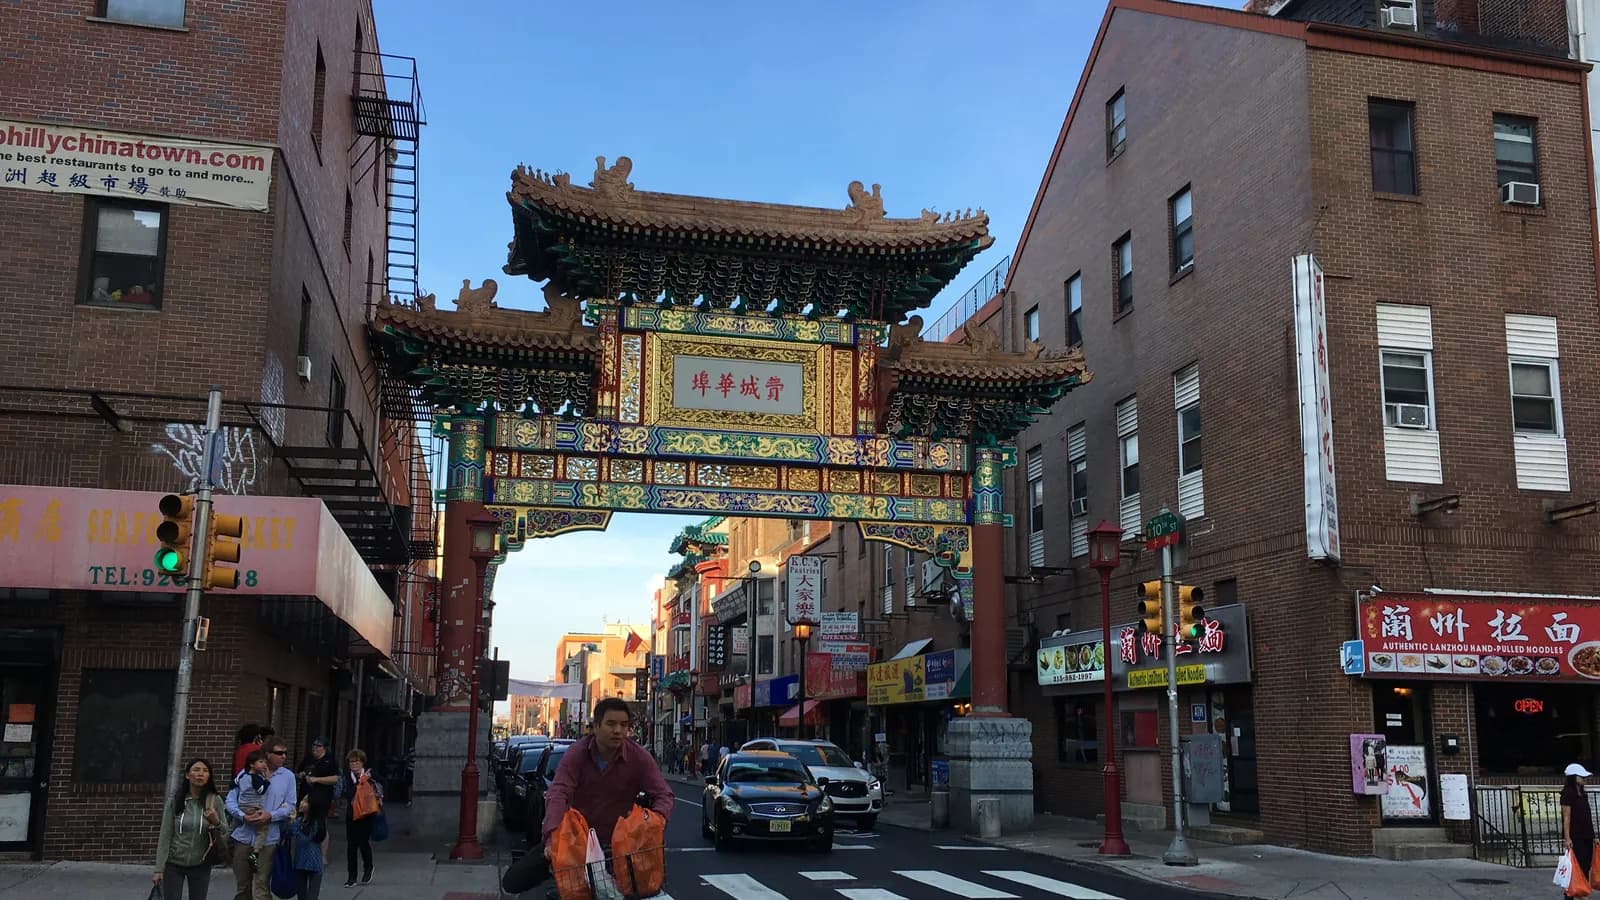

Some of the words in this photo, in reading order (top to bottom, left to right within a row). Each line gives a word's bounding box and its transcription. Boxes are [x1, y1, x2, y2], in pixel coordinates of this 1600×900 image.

[17, 152, 46, 164] best
[50, 156, 126, 172] restaurants
[131, 164, 144, 174] to
[148, 167, 163, 177] go
[168, 167, 181, 177] to
[185, 169, 208, 180] and
[211, 173, 254, 185] more...
[790, 567, 820, 575] Pastries
[795, 575, 815, 618] 大家樂
[716, 626, 724, 665] PENANG
[1382, 642, 1428, 651] AUTHENTIC
[1430, 644, 1469, 653] LANZHOU
[1470, 645, 1525, 654] HAND-PULLED
[1526, 646, 1564, 654] NOODLES
[1514, 699, 1544, 713] OPEN
